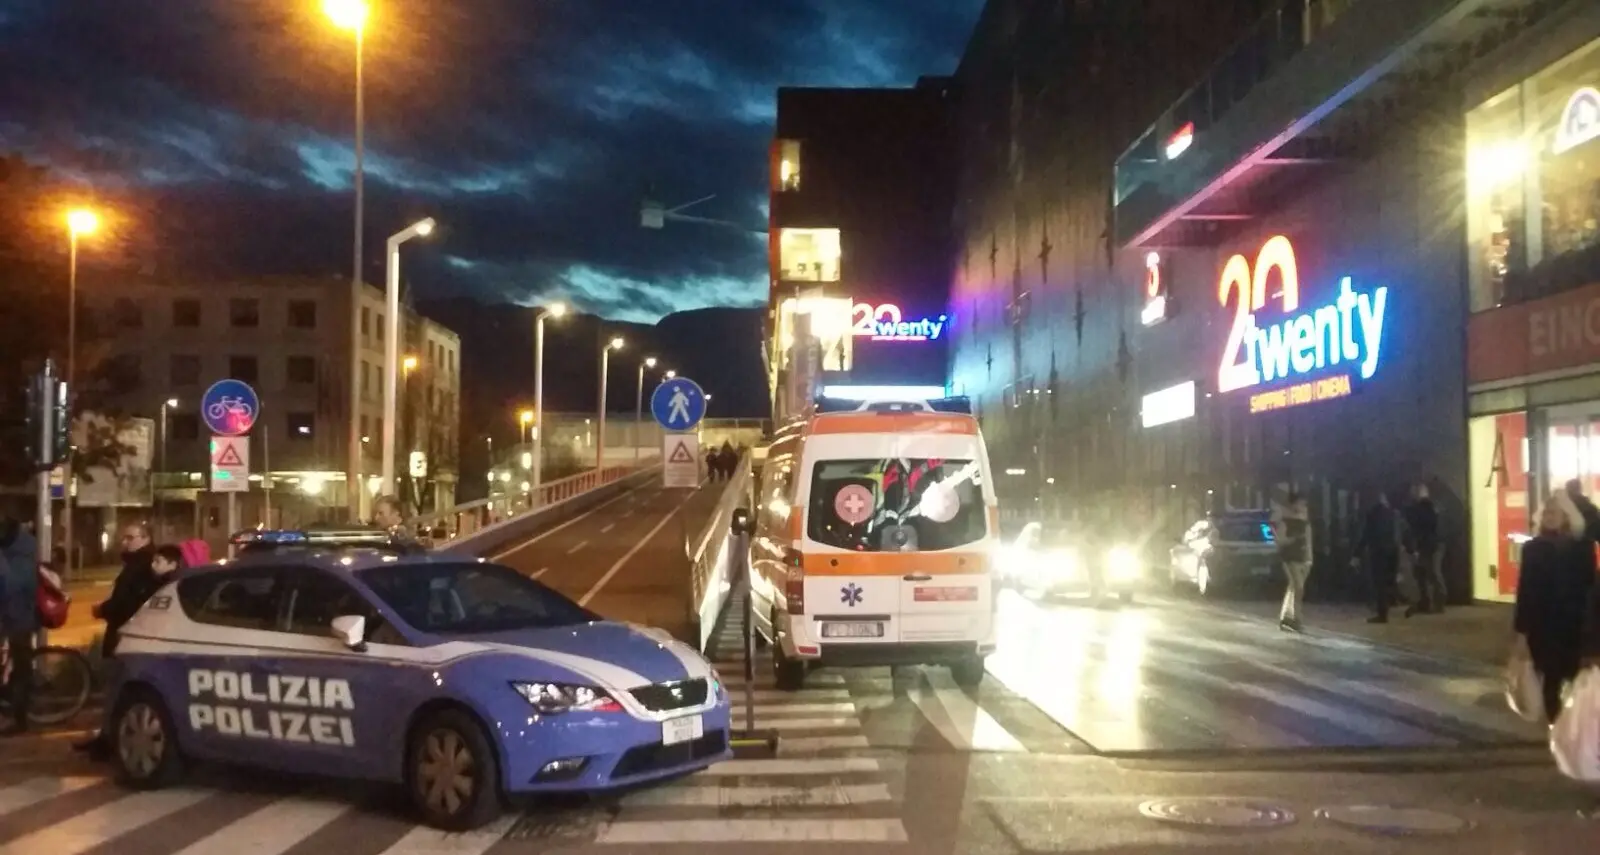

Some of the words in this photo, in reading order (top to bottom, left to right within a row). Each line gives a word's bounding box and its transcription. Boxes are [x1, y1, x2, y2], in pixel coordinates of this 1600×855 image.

[872, 317, 943, 340] twenty
[1244, 276, 1388, 381] twenty
[188, 668, 355, 710] POLIZIA
[188, 703, 356, 747] POLIZEI
